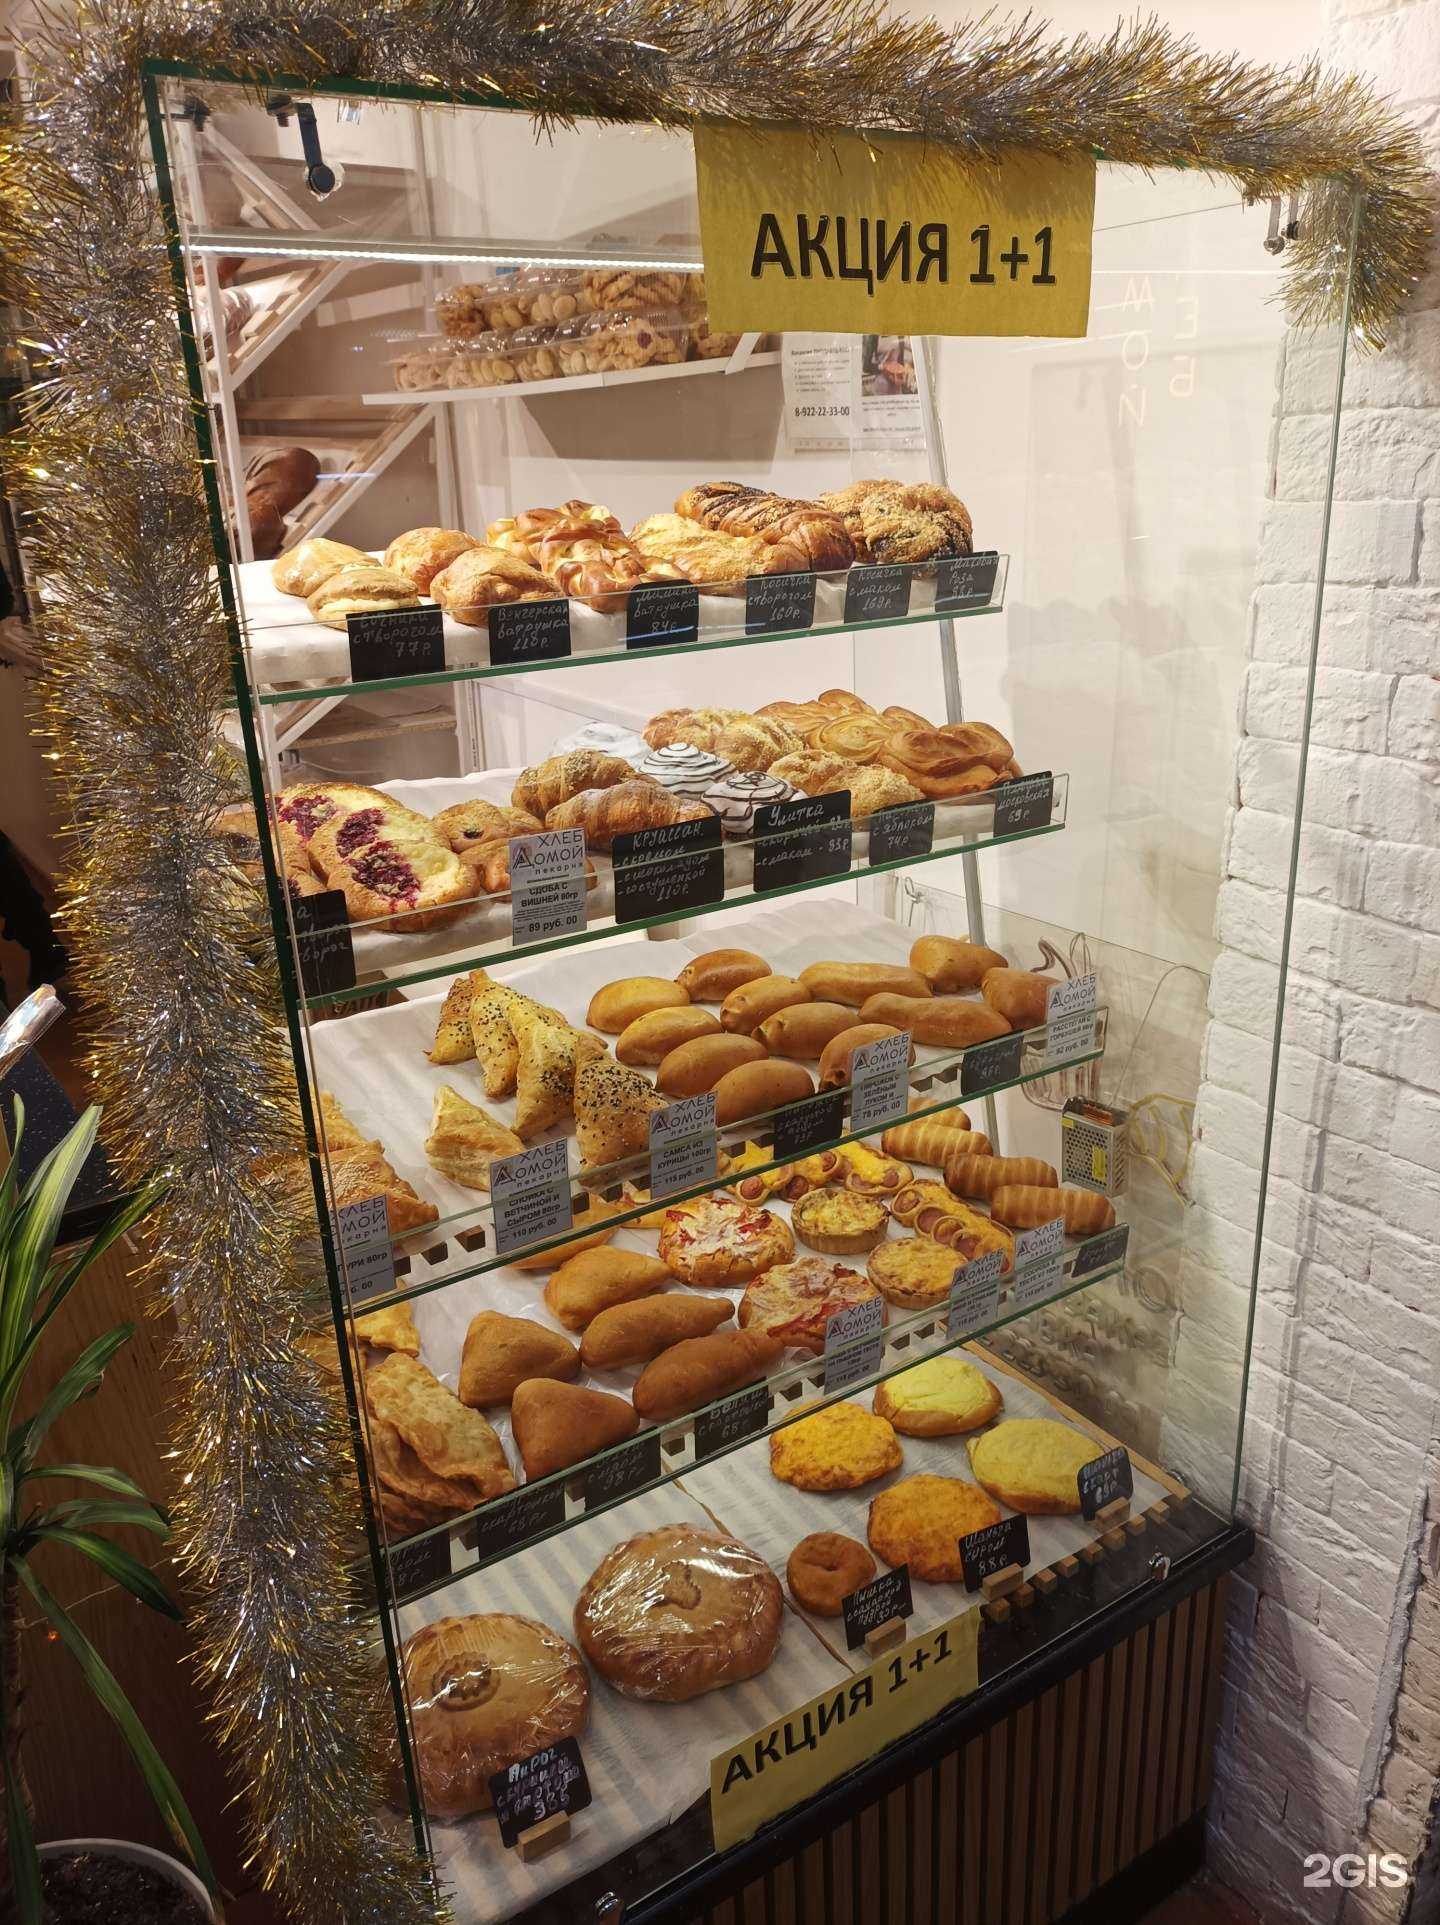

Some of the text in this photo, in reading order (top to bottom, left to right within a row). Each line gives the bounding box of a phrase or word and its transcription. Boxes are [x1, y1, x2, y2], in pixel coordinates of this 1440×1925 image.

[751, 212, 1056, 296] АКЦИЯ 1+1
[795, 406, 850, 417] 8-922-22-33-00
[768, 804, 825, 827] Улитка
[538, 829, 582, 848] ХЛЕБ
[521, 893, 559, 908] ВИШНЕЙ
[529, 921, 541, 933] 89
[1067, 973, 1096, 992] ХЛЕБ
[875, 1032, 909, 1052] ХЛЕБ
[673, 1092, 716, 1113] ХЛЕБ
[519, 1140, 565, 1163] ХЛЕБ
[848, 1295, 881, 1319] ХЛЕБ
[722, 1630, 953, 1795] АКЦИЯ 1+1
